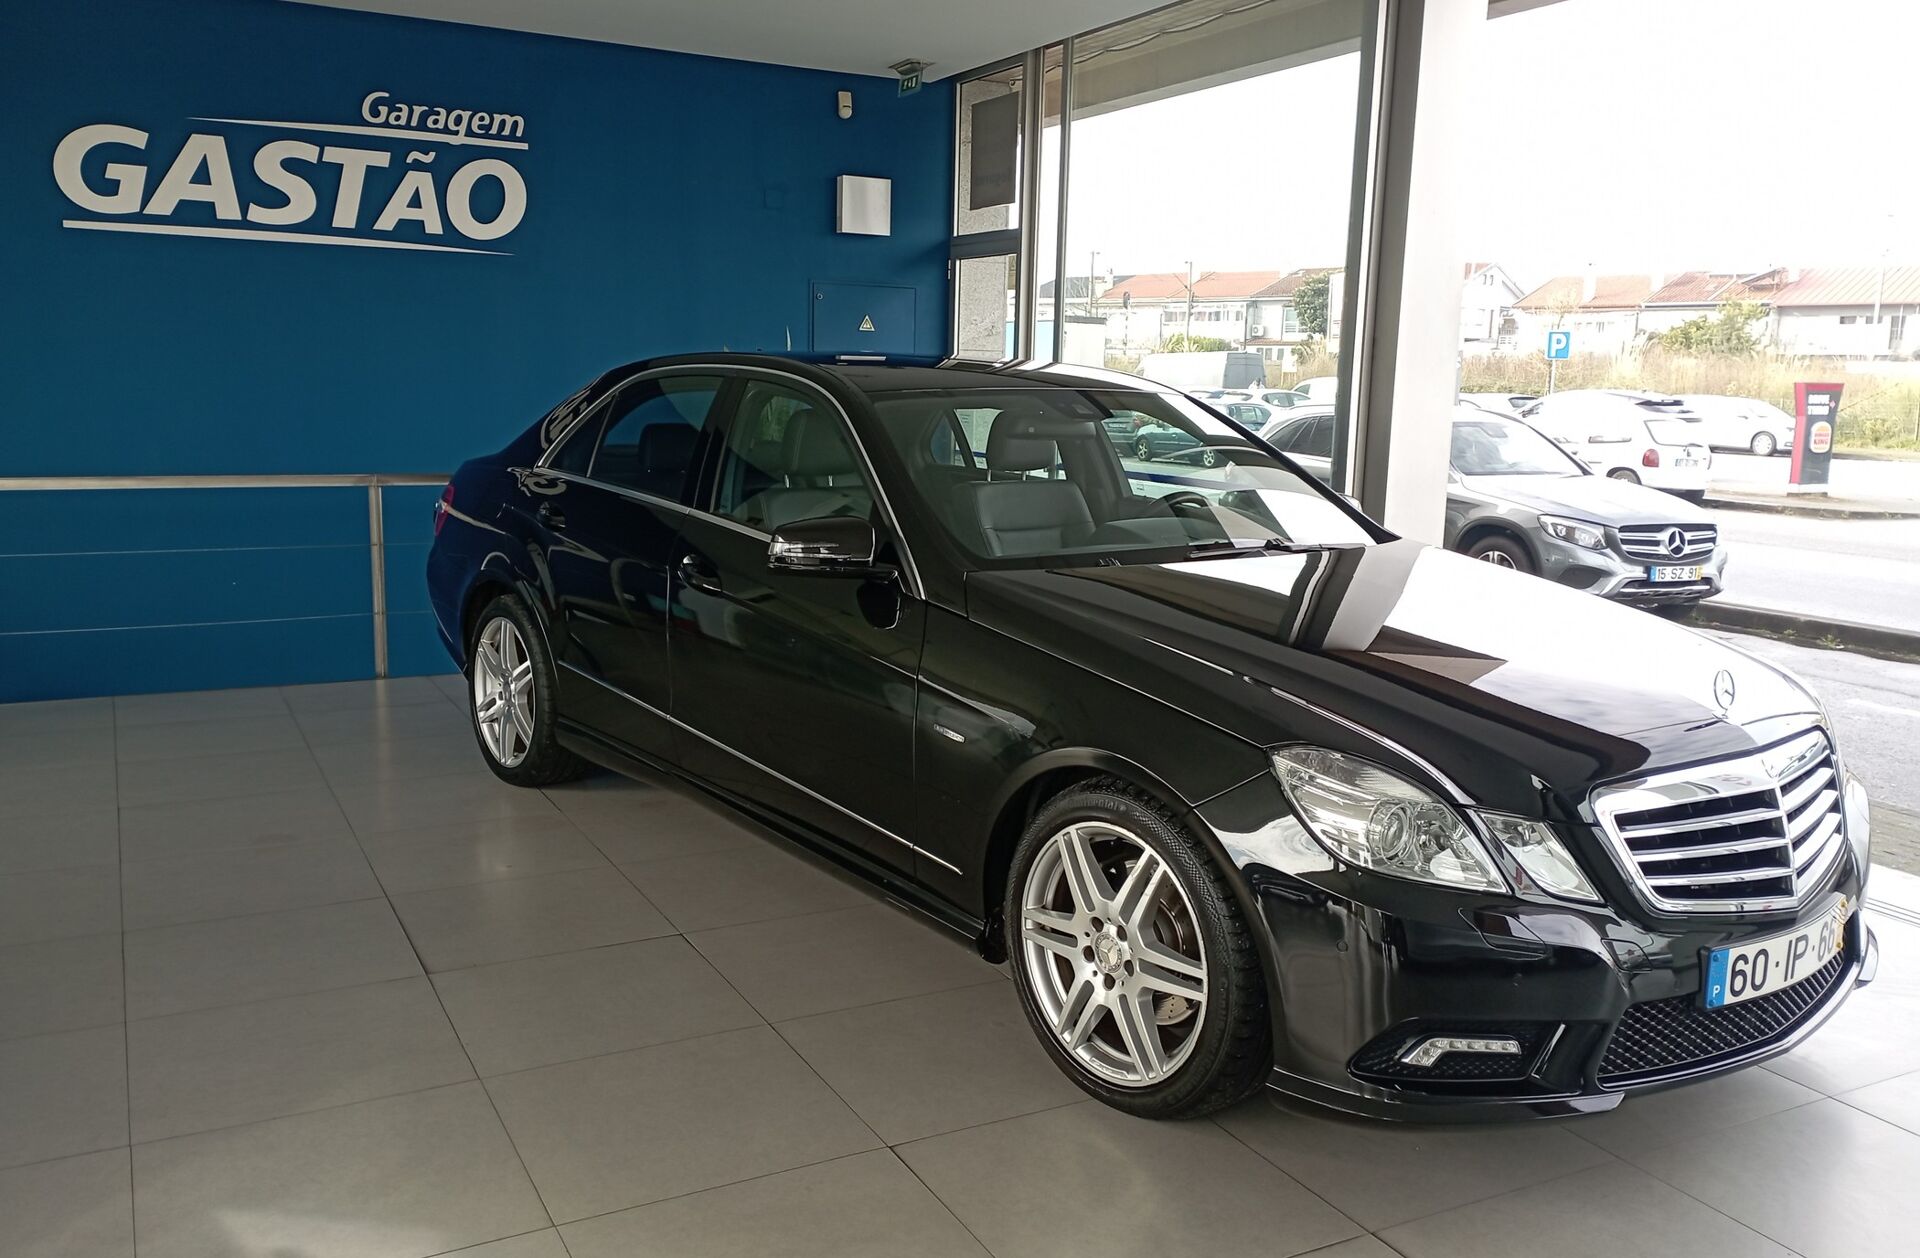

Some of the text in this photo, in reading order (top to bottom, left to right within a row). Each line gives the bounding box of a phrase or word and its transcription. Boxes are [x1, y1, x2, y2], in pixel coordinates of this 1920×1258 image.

[361, 91, 525, 145] Garagem
[52, 123, 528, 241] GASTÃO
[1551, 333, 1567, 357] P
